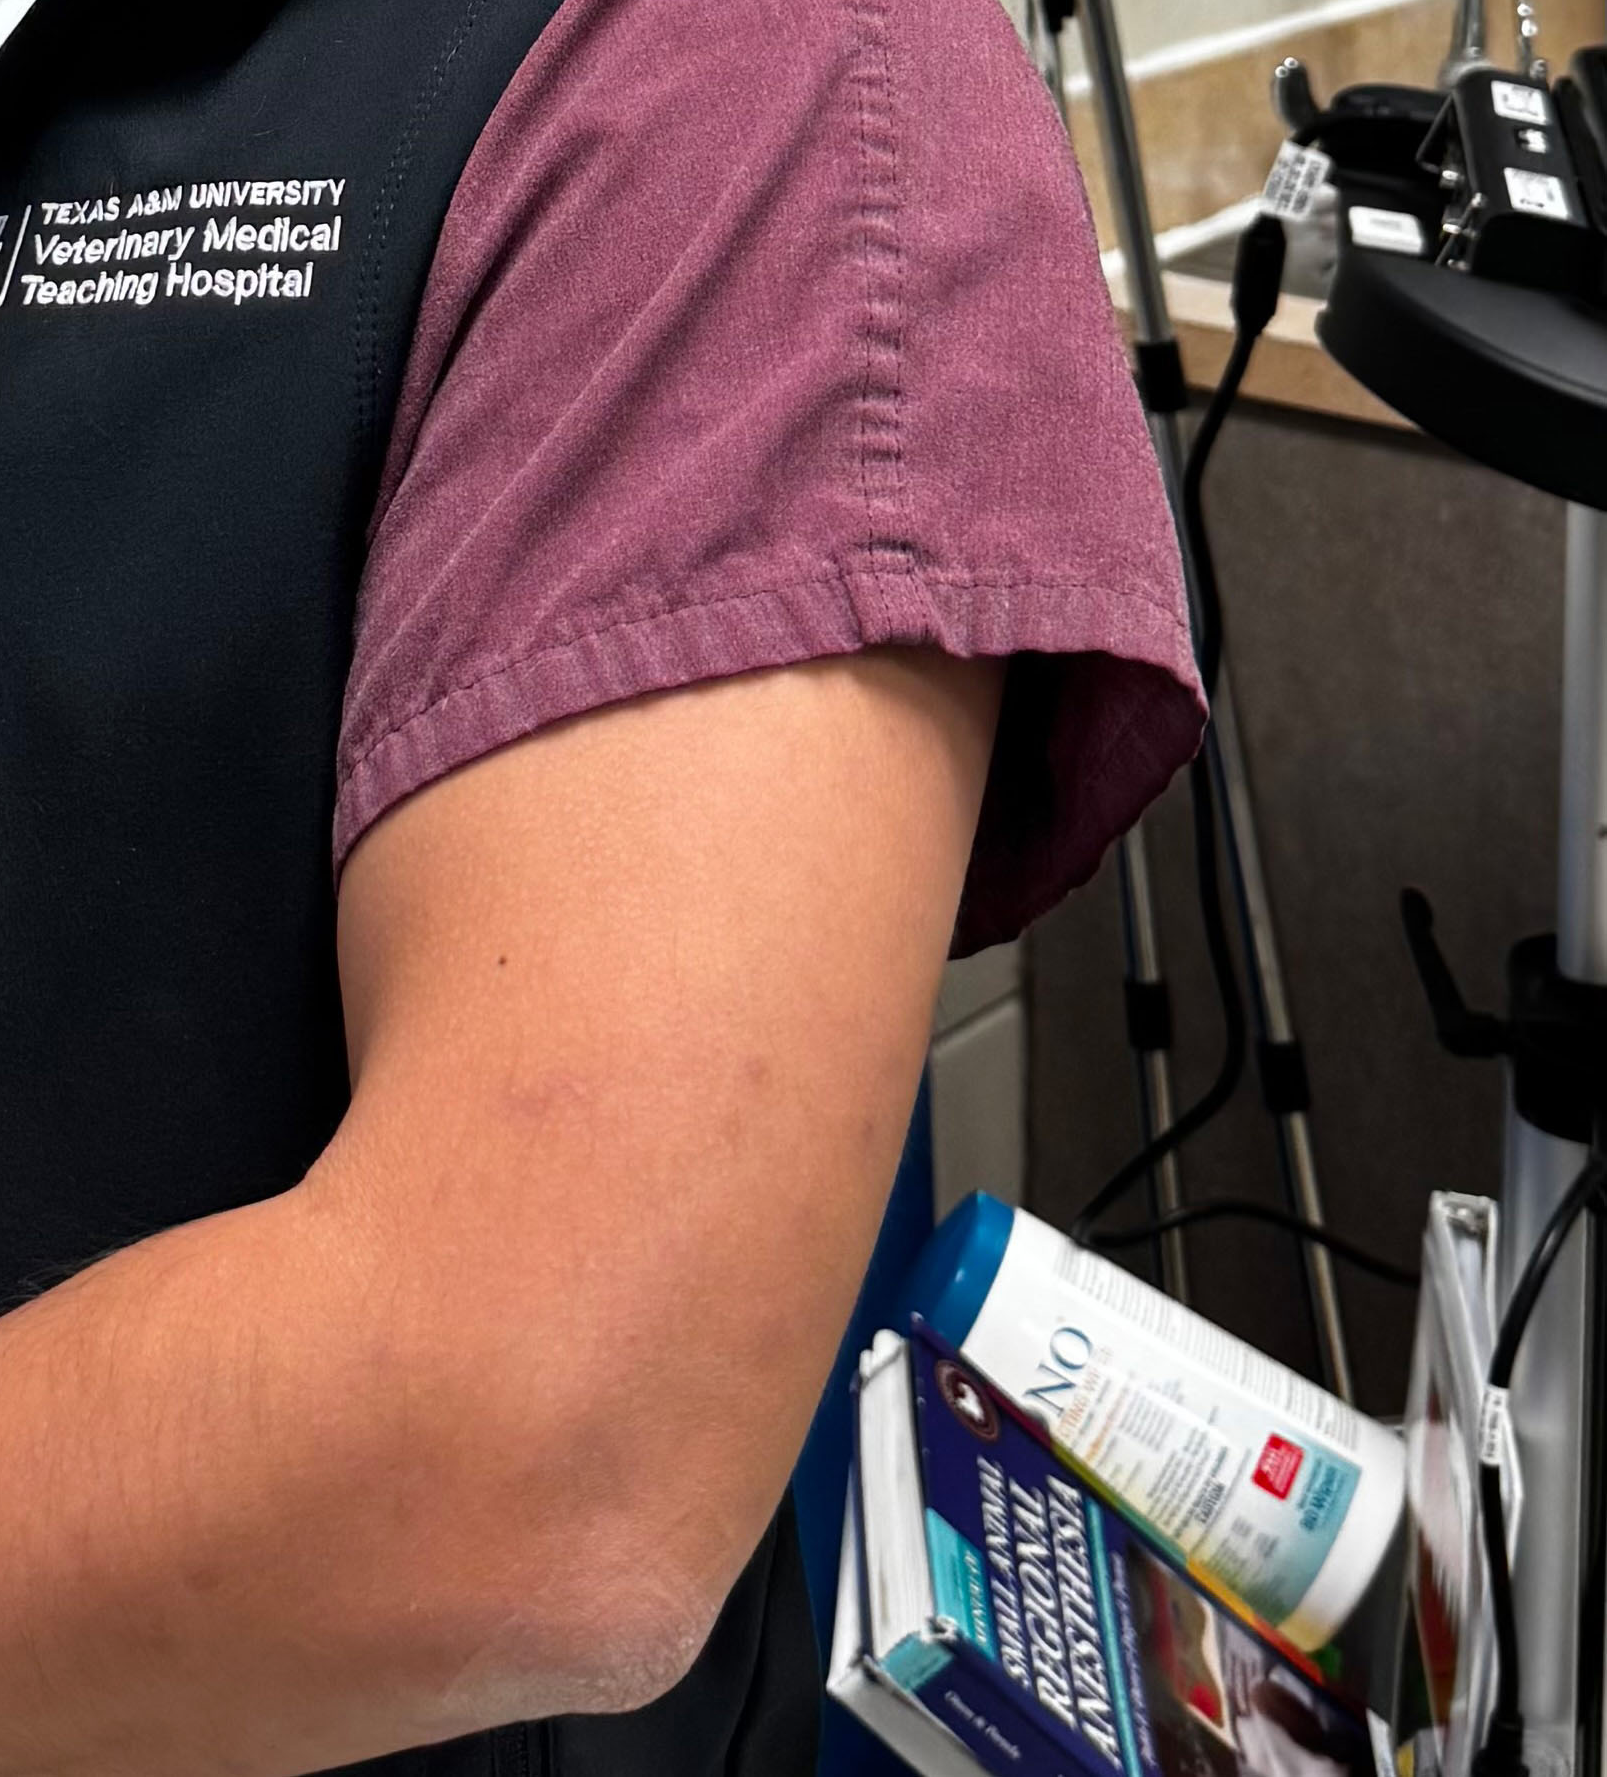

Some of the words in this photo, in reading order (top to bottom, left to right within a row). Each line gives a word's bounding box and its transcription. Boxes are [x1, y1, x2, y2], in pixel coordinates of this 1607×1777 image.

[33, 224, 194, 267] Veterinary
[202, 217, 342, 254] Medical
[41, 196, 120, 225] TEXAS
[126, 184, 185, 217] A&M
[190, 178, 346, 208] UNIVERSITY
[19, 267, 158, 306] Teaching
[166, 262, 314, 305] Hospital
[977, 1456, 1016, 1564] ANIMAL
[990, 1569, 1034, 1689] SMALL
[1009, 1480, 1079, 1730] REGIONAL
[1046, 1475, 1124, 1769] ANESTHESIA
